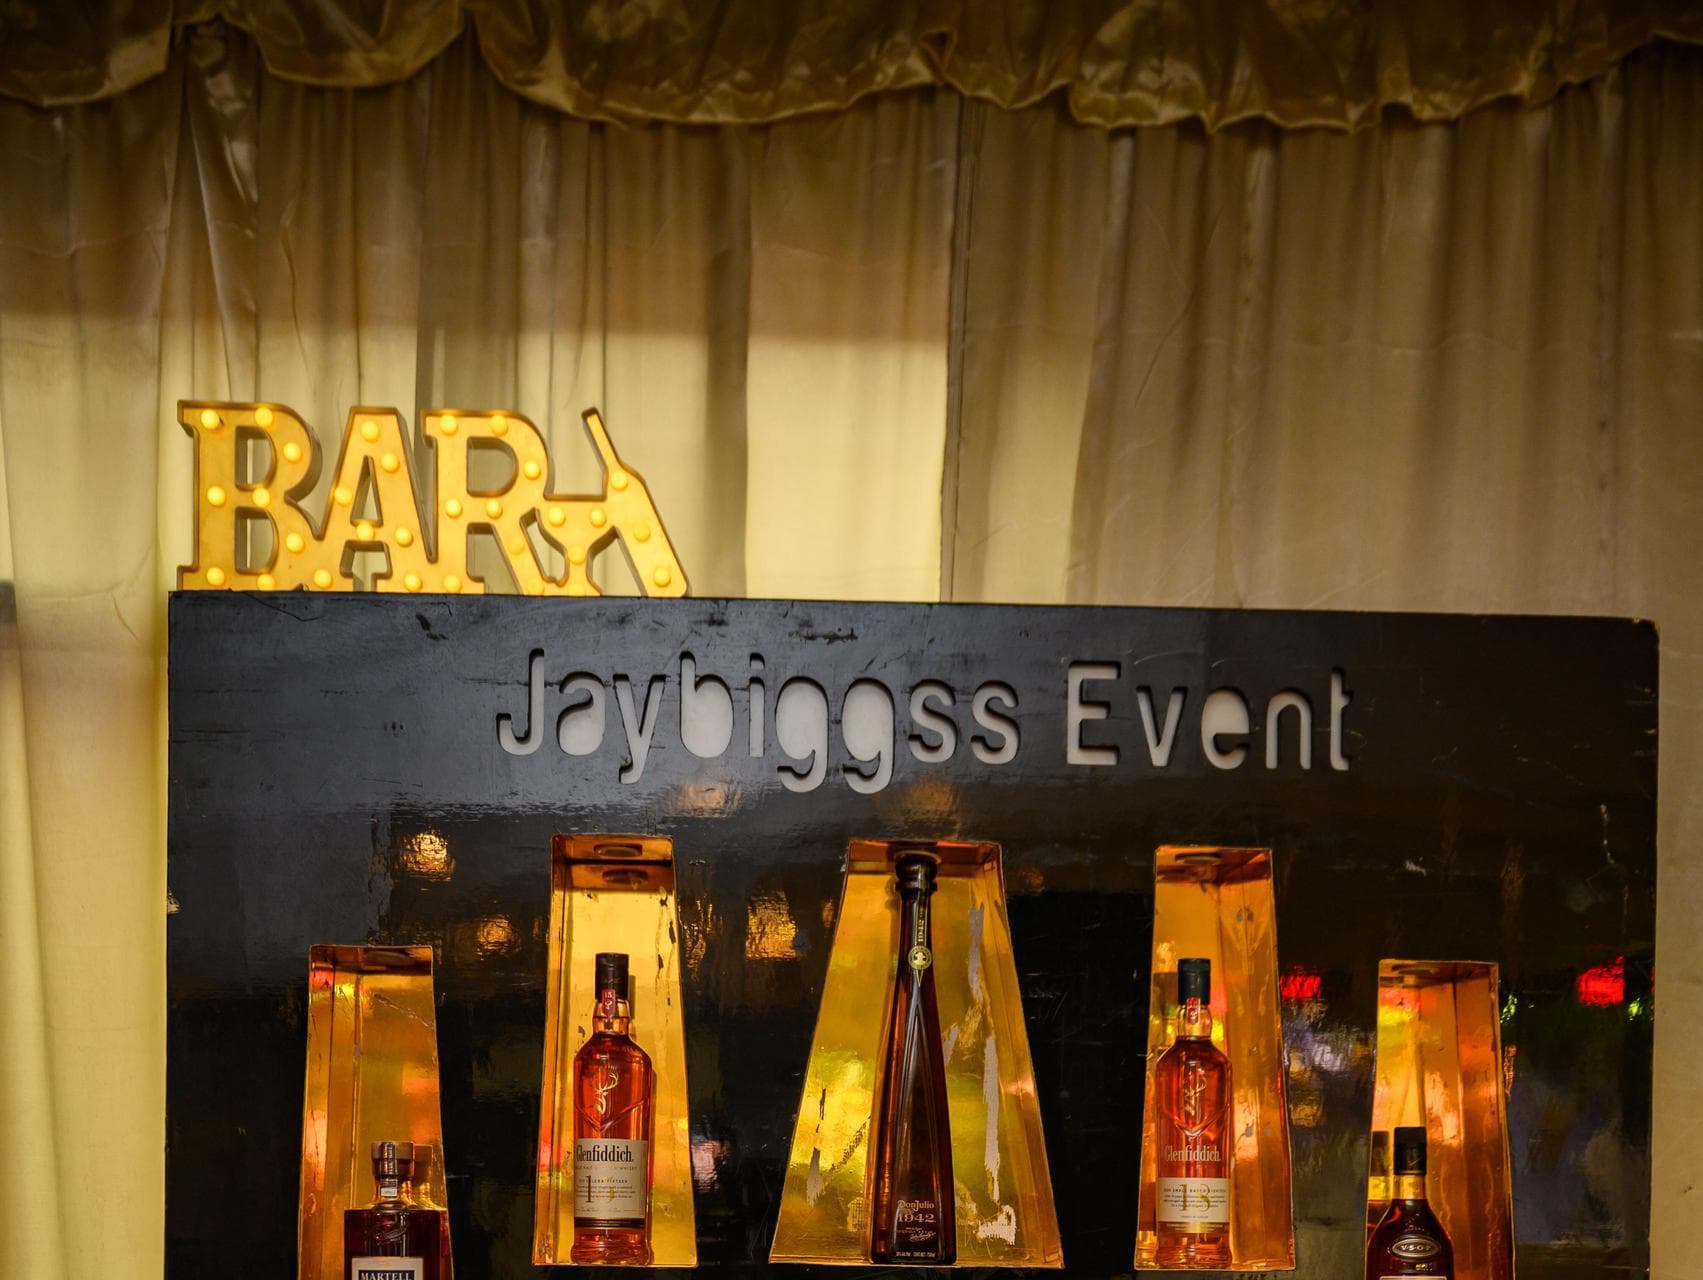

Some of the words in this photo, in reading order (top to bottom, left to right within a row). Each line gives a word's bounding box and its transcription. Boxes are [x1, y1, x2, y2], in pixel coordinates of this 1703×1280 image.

[177, 400, 552, 596] BAR
[496, 648, 1020, 794] Jaybiggss
[1066, 660, 1353, 771] Event
[898, 1213, 937, 1223] 1942
